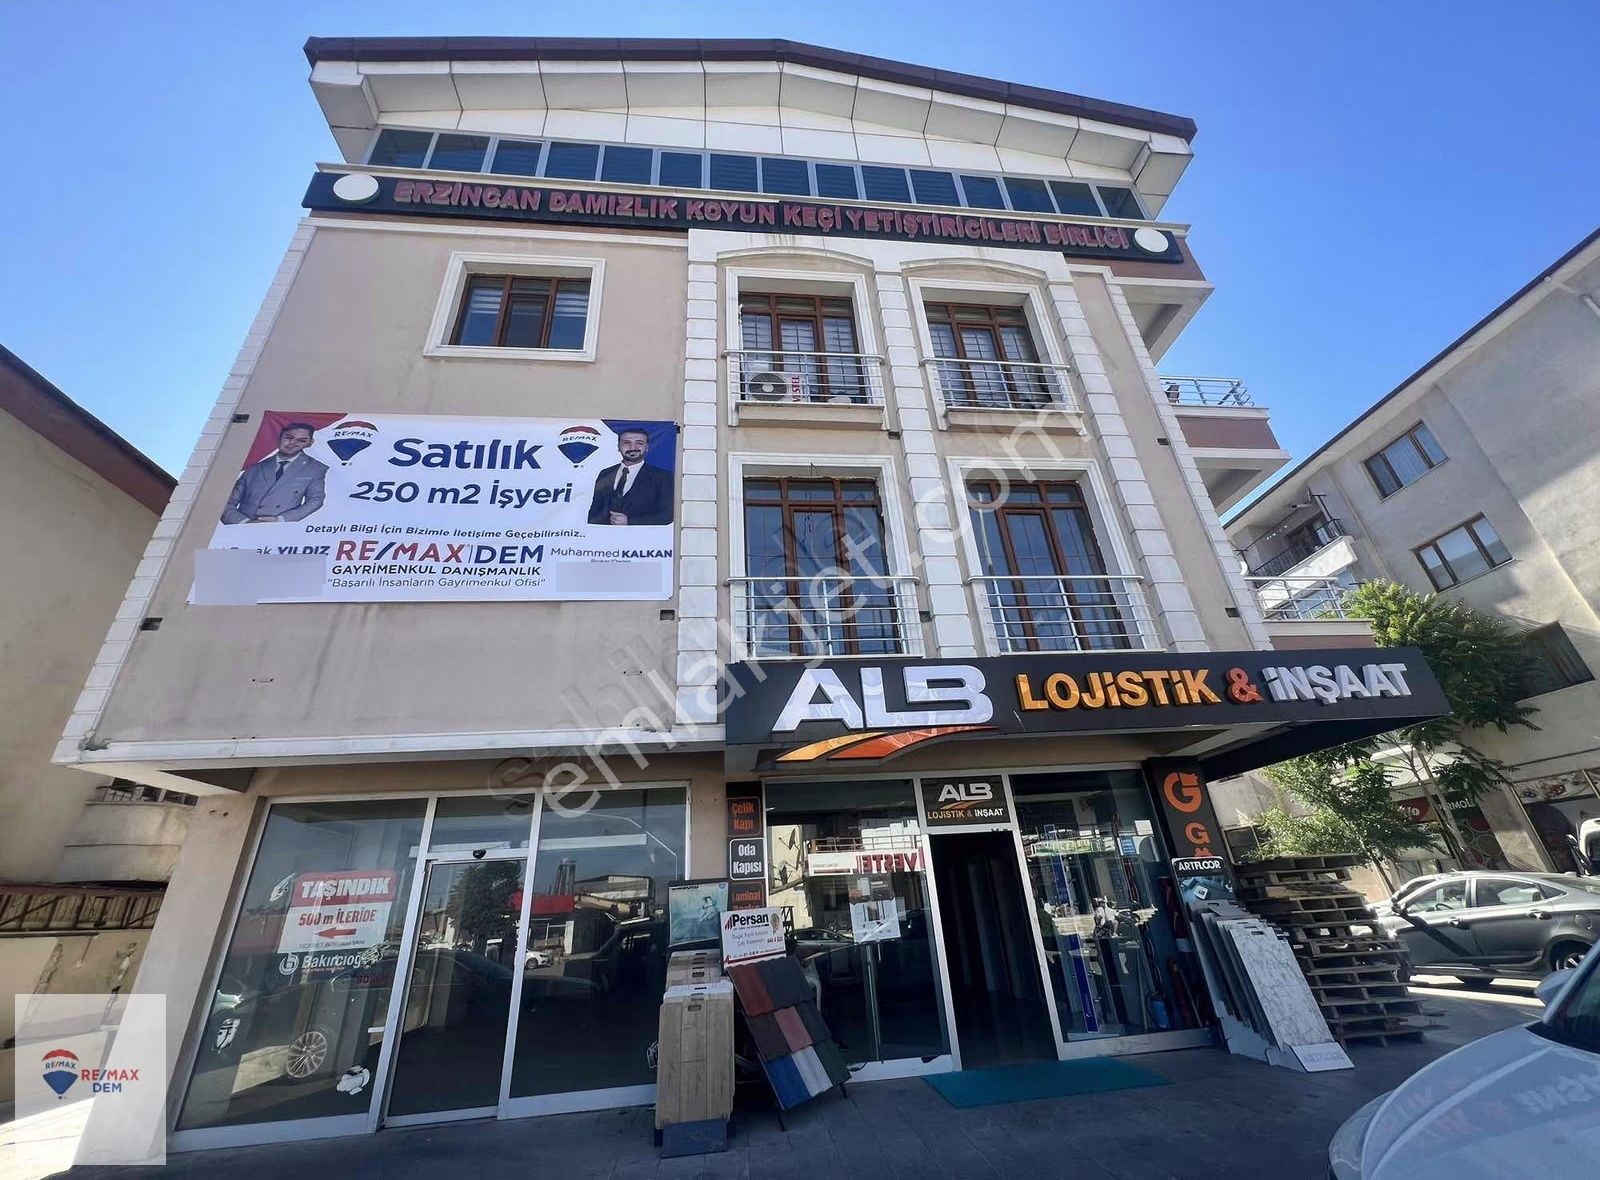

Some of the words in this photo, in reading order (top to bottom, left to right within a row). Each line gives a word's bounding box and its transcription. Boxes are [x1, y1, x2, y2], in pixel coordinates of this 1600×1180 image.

[549, 191, 678, 220] DAMIZLIK
[685, 199, 777, 227] KOYUN
[783, 204, 843, 233] KEÇİ
[334, 430, 373, 438] RE/MAX
[388, 438, 543, 470] Satılık
[349, 481, 420, 502] 250
[428, 484, 481, 505] m2
[489, 479, 573, 509] İşyeri
[305, 524, 347, 535] Detaylı
[350, 524, 378, 536] Bilgi
[381, 524, 402, 537] İçin
[406, 526, 450, 538] Bizimle
[453, 528, 502, 540] İletişime
[277, 545, 331, 556] YILDIZ
[335, 540, 466, 563] RE/MAX
[474, 544, 544, 564] DEM
[550, 547, 620, 558] Muhammed
[621, 549, 673, 558] KALKAN
[332, 563, 436, 576] GAYRİMENKUL
[441, 566, 541, 577] DANIŞMANLIK
[378, 577, 434, 588] İnsanların
[438, 577, 511, 588] Gayrimenkul
[1225, 667, 1264, 704] &
[772, 665, 994, 732] ALB
[938, 782, 993, 802] ALB
[738, 844, 756, 856] Oda
[733, 861, 762, 875] Kapısı
[1178, 859, 1221, 871] ARTFLOOR
[301, 877, 391, 900] TAŞINDIK
[298, 912, 321, 926] 500
[323, 914, 334, 924] m
[335, 907, 377, 924] İLERİDE
[732, 913, 769, 926] Persan
[301, 951, 364, 969] Bakırcıoğ
